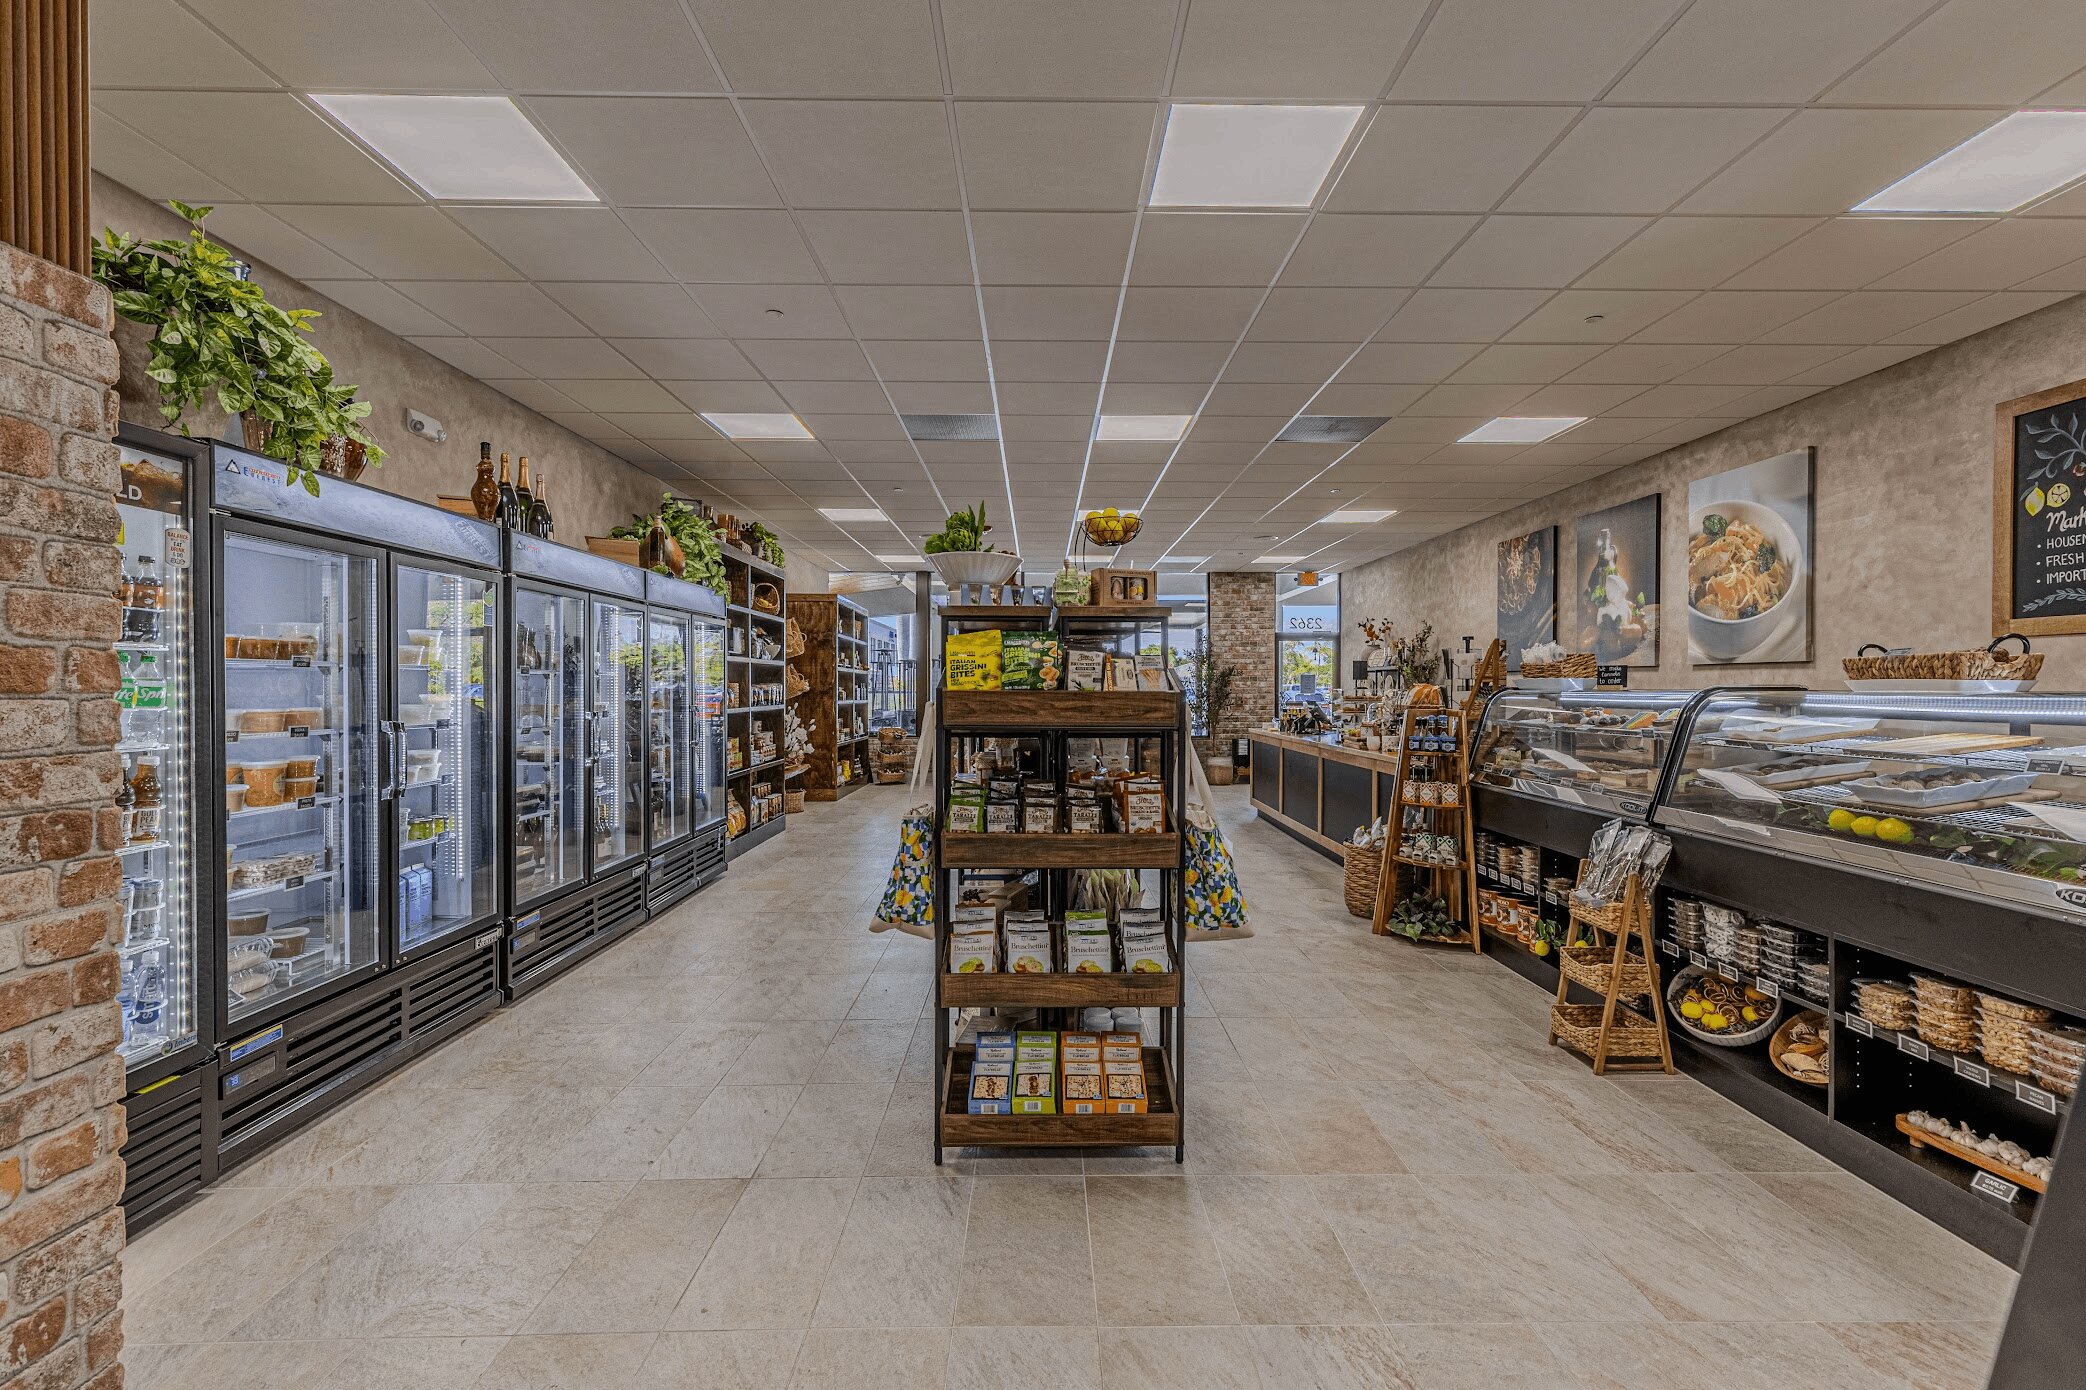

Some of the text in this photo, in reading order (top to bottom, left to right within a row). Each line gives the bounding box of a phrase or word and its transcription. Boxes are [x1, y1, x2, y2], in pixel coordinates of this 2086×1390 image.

[2046, 552, 2084, 567] FRESH
[950, 663, 987, 671] GRISSINI
[950, 670, 976, 679] BITES
[1984, 1178, 2007, 1191] GARLIC
